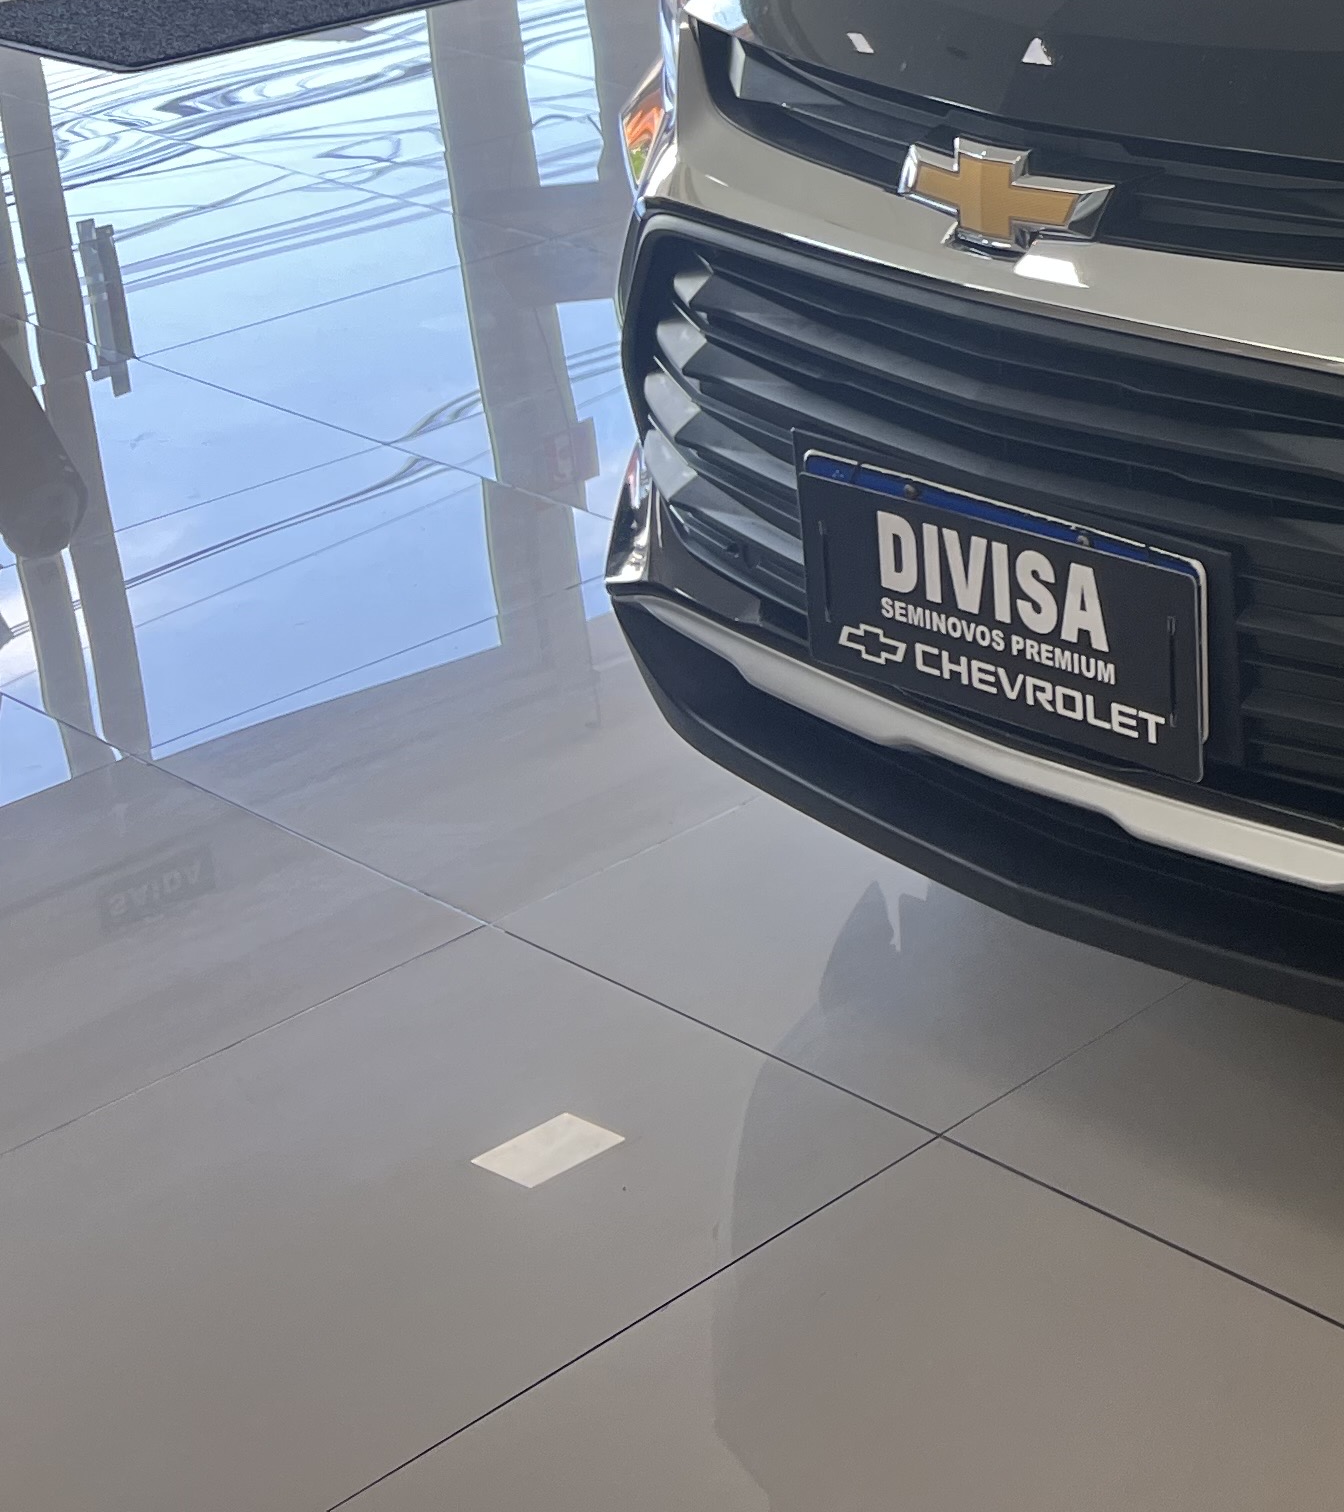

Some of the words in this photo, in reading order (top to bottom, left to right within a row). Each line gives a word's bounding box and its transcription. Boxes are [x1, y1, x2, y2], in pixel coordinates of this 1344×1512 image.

[877, 510, 1109, 652] DIVISA
[880, 596, 1006, 652] SEMINOVOS
[1011, 633, 1117, 685] PREMIUM
[915, 641, 1166, 745] CHEVROLET
